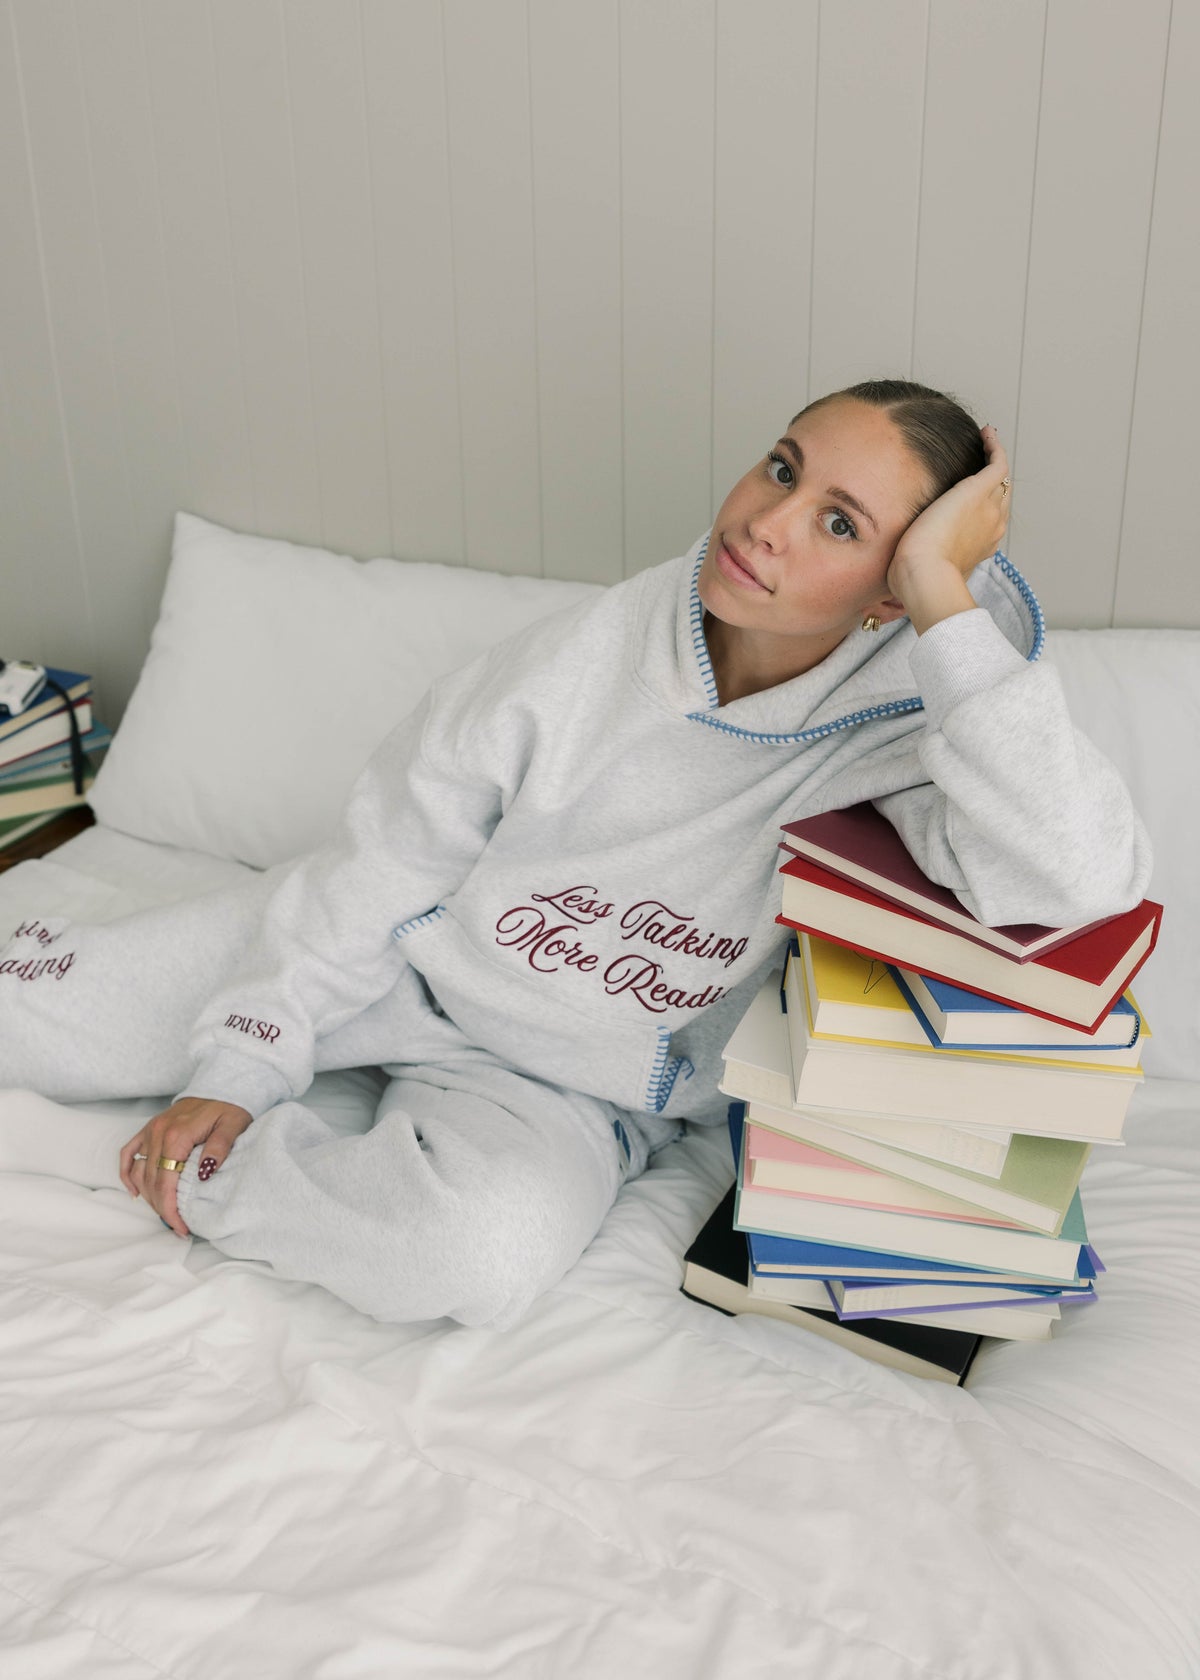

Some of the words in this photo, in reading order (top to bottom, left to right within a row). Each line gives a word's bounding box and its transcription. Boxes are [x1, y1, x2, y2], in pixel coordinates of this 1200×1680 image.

[496, 906, 599, 973] More
[531, 885, 615, 925] Less
[620, 900, 749, 968] Talking
